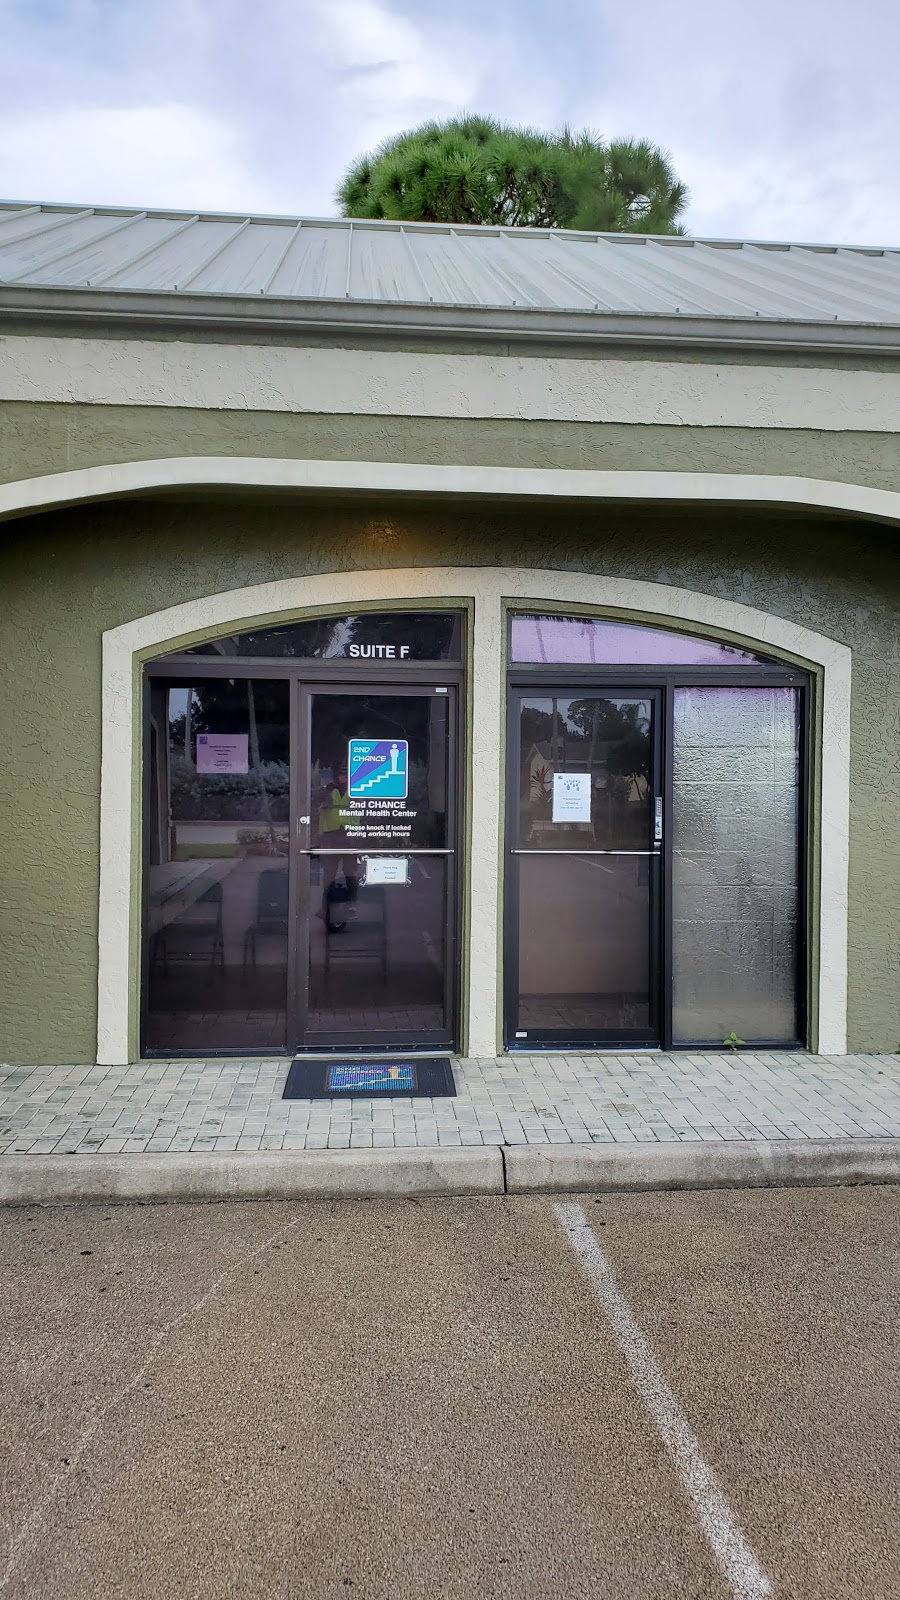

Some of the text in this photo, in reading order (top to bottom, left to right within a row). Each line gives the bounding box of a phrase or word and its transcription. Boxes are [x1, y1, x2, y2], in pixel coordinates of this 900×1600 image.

[349, 644, 410, 659] SUITE F
[349, 801, 406, 809] 2nd CHANCE
